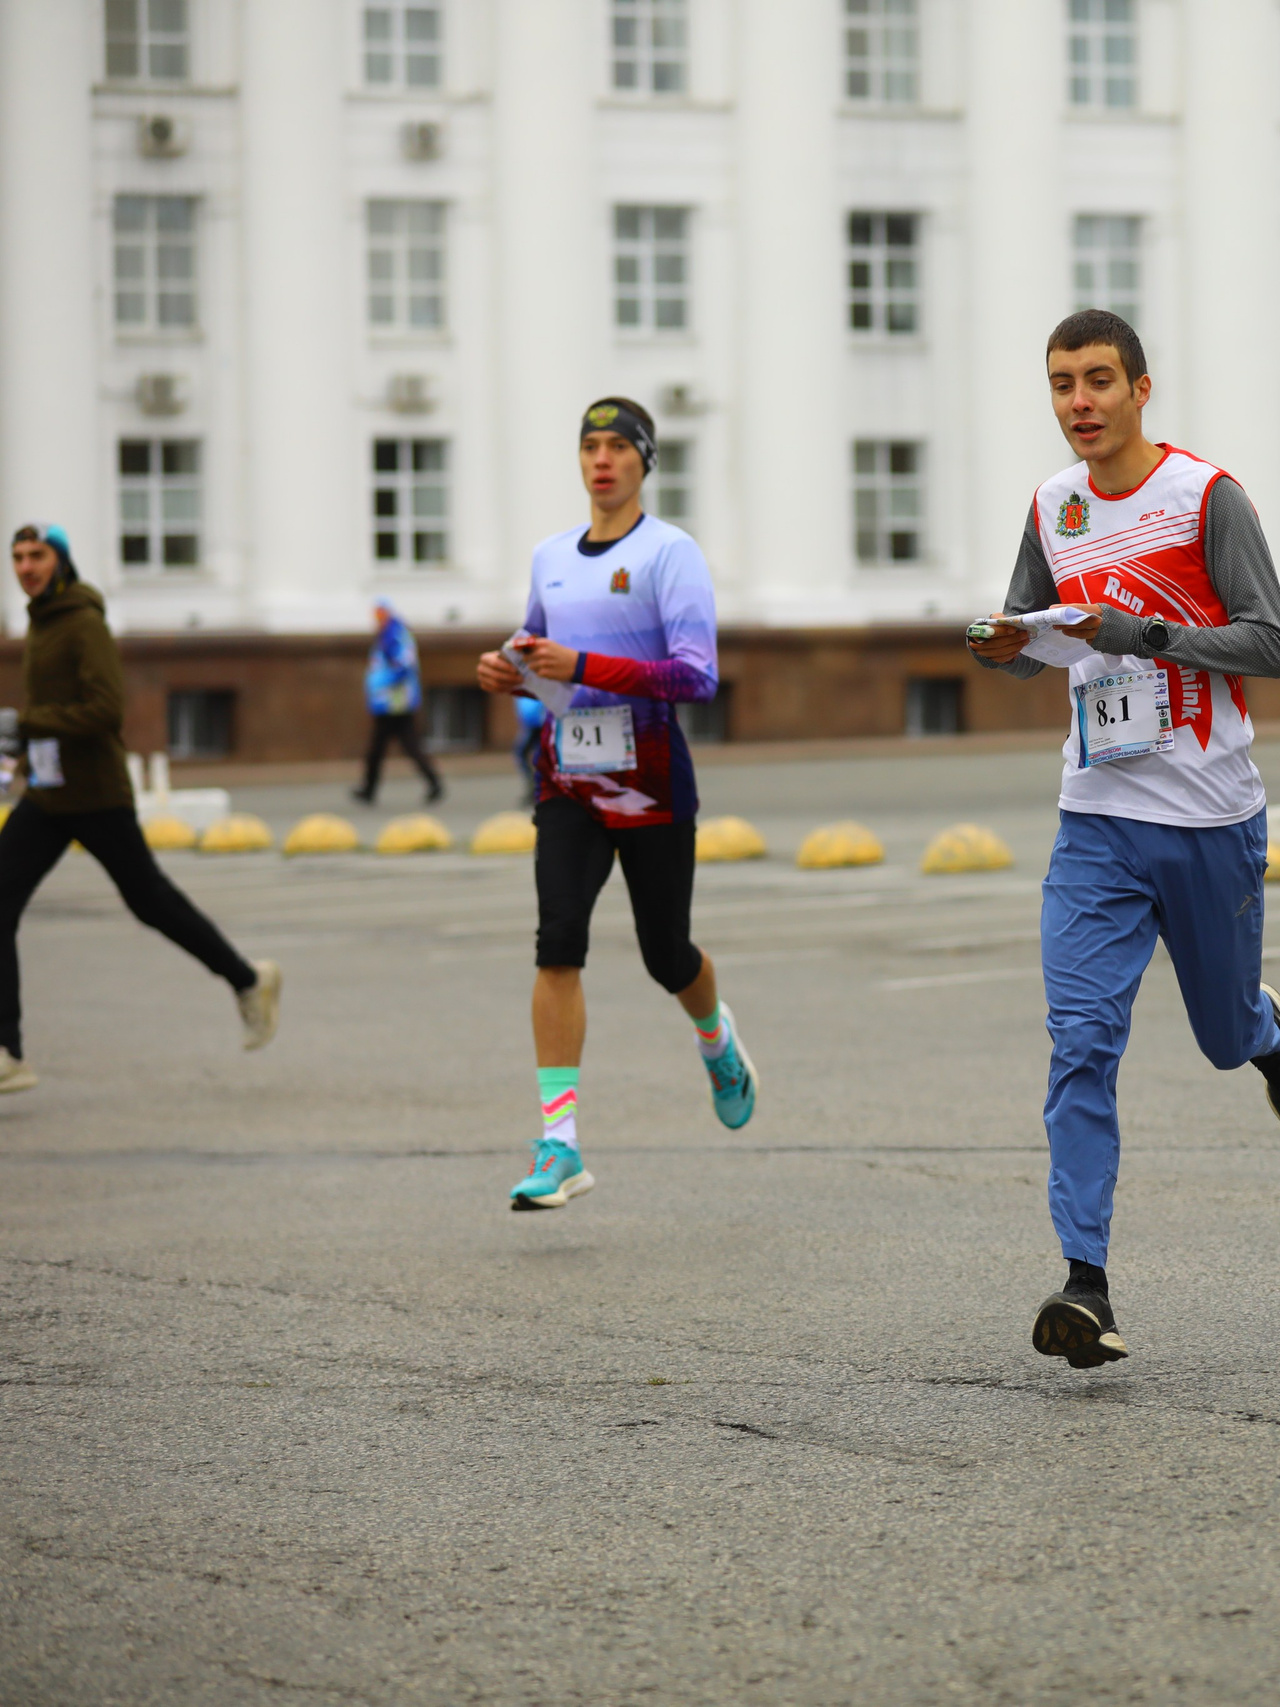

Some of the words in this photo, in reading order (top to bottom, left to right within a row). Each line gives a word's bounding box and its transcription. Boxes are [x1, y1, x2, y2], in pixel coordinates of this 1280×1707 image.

[1104, 575, 1145, 614] Run
[1178, 664, 1203, 721] hink
[1096, 695, 1132, 727] 8.1
[572, 724, 602, 747] 9.1
